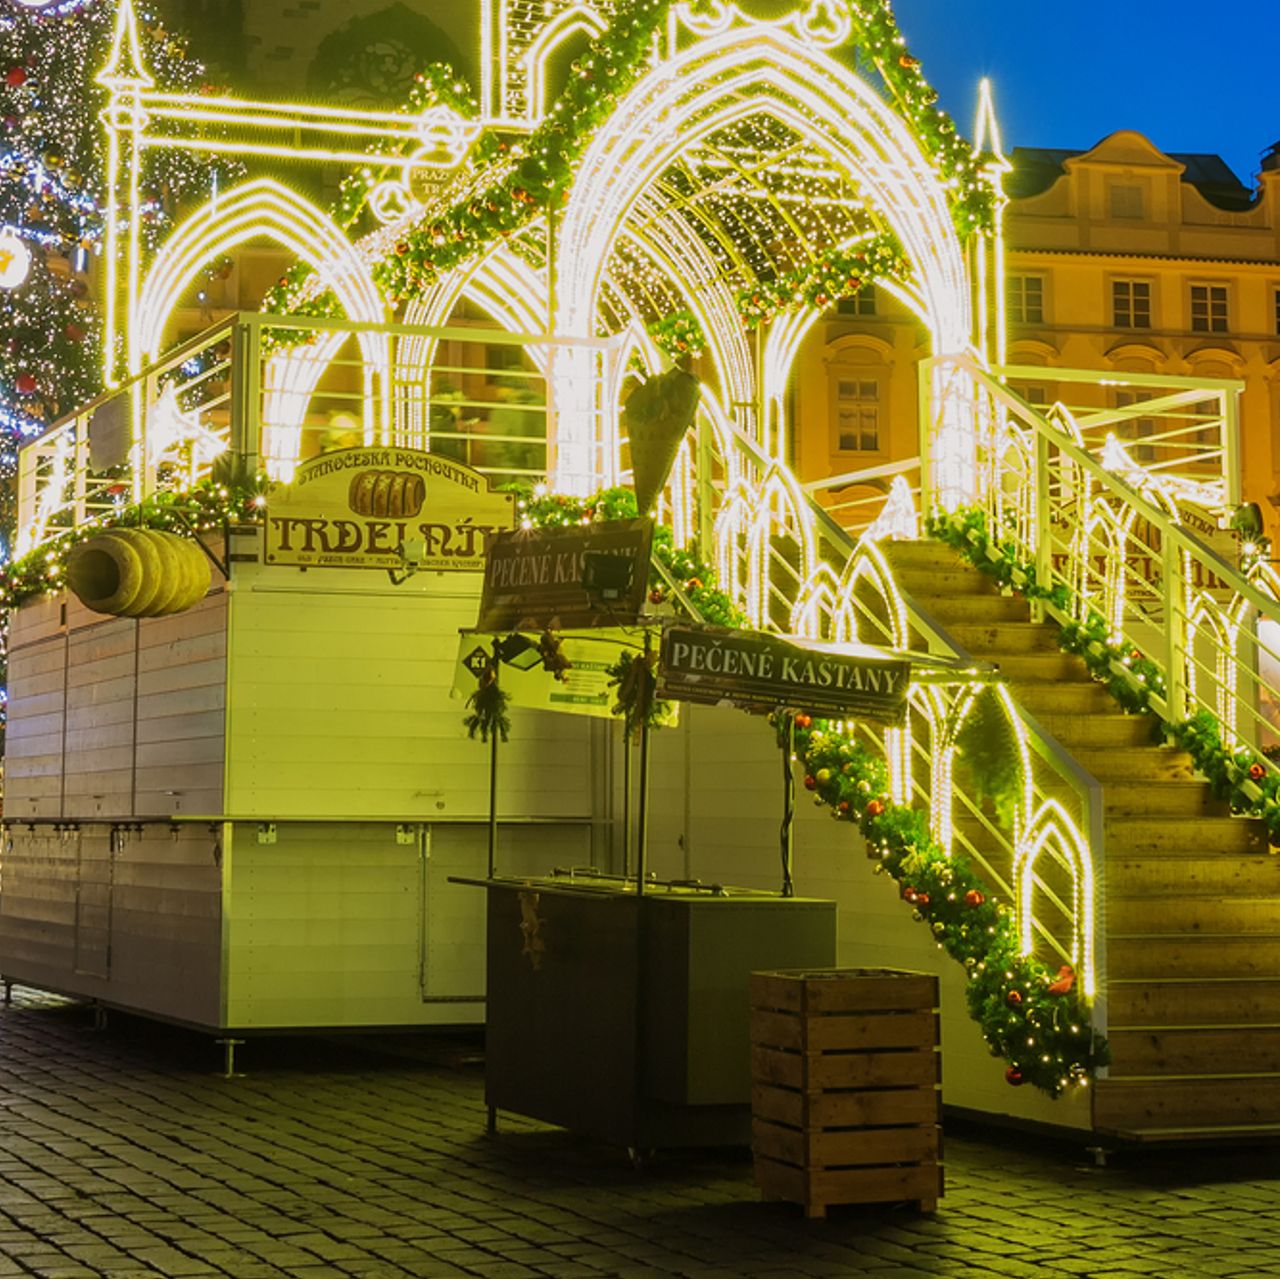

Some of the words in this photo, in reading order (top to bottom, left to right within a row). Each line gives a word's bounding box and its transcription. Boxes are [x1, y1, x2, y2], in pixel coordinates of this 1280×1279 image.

[298, 452, 391, 486] STAROČESKÁ
[395, 453, 480, 493] POCHOUTKA
[490, 545, 552, 588] PEČENÉ
[672, 639, 774, 679] PEČENÉ
[781, 656, 900, 694] KAŠTANY
